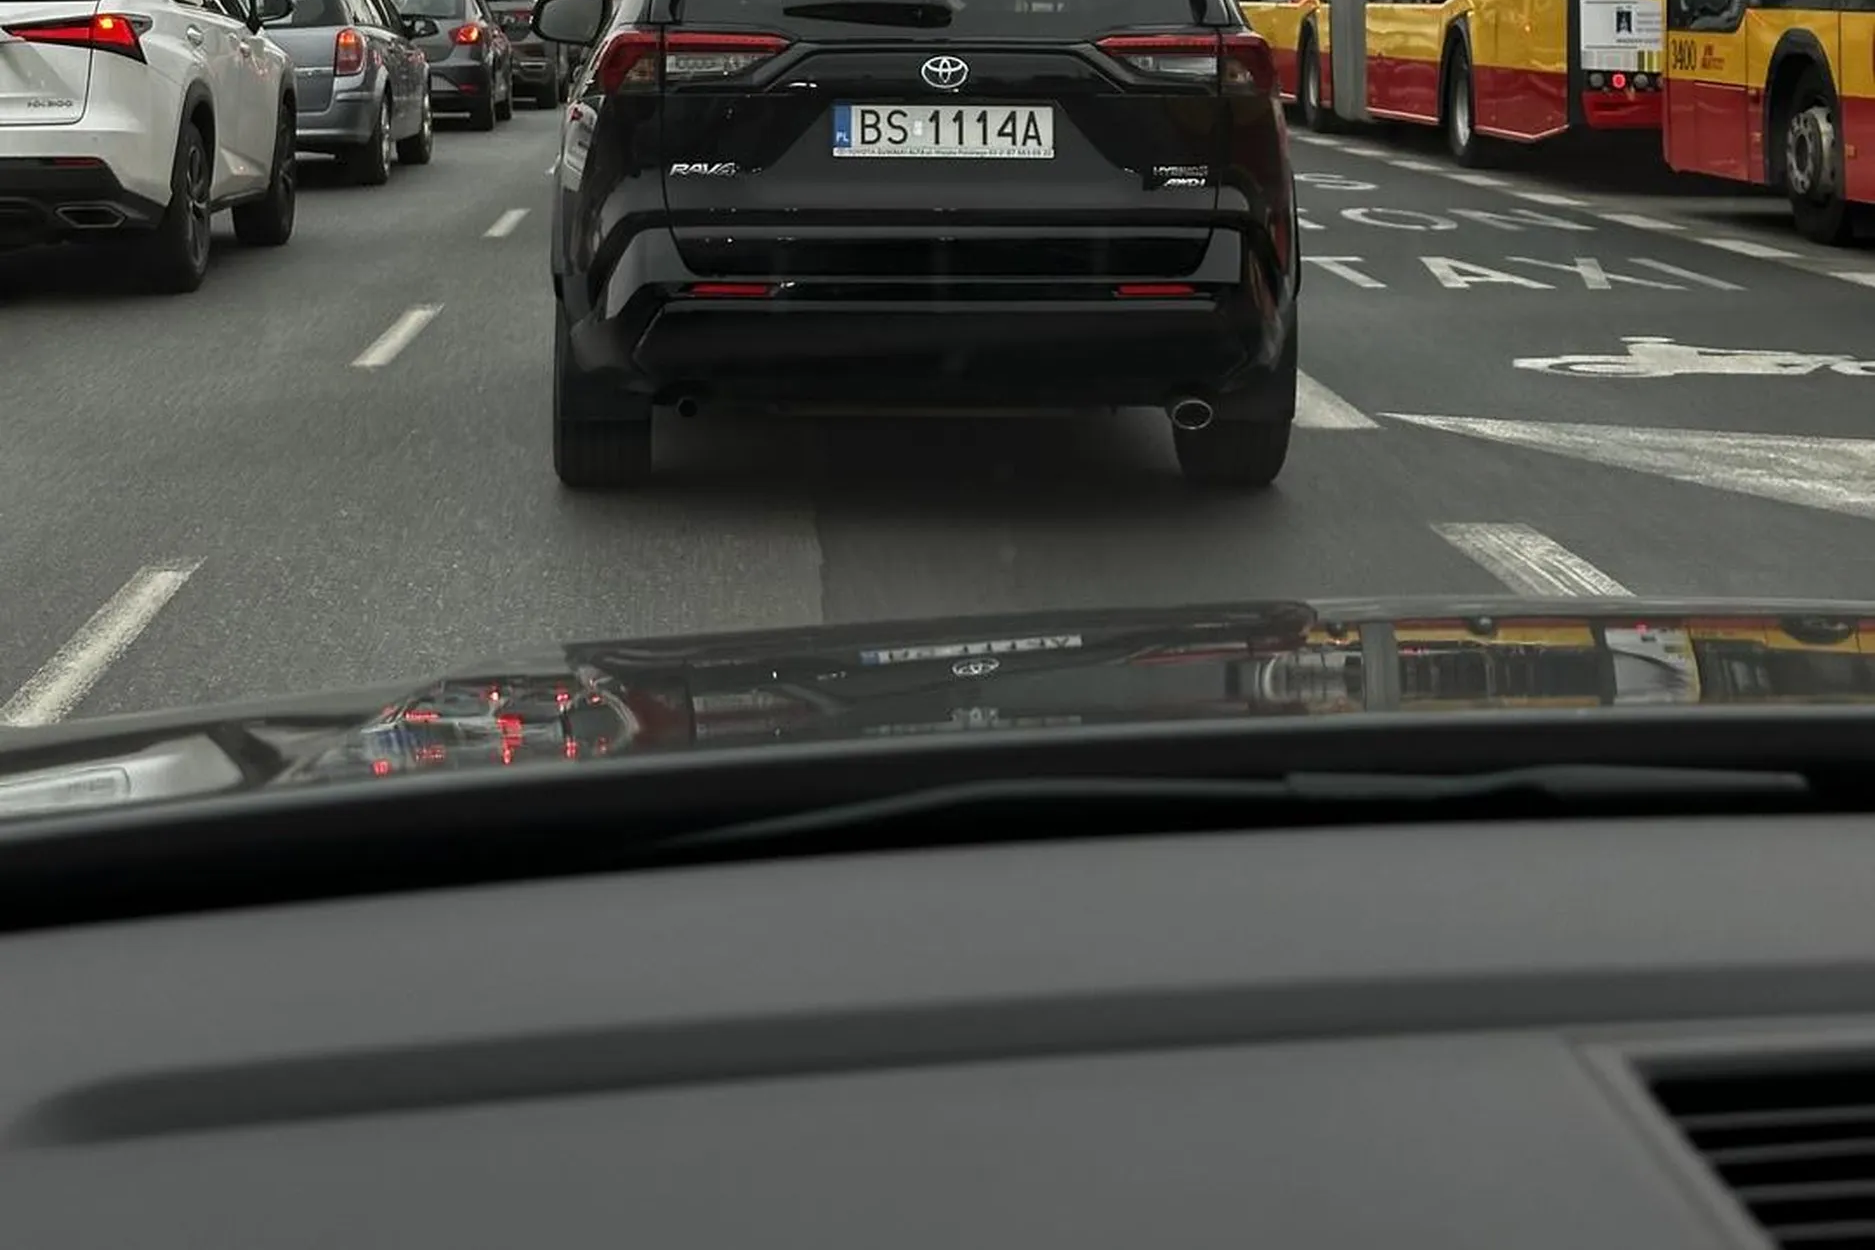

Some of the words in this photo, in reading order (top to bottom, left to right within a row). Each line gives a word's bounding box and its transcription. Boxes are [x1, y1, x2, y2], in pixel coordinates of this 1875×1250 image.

[836, 132, 849, 142] PL
[860, 109, 908, 145] BS
[928, 109, 1042, 146] 1114A
[1300, 255, 1747, 290] TAXI
